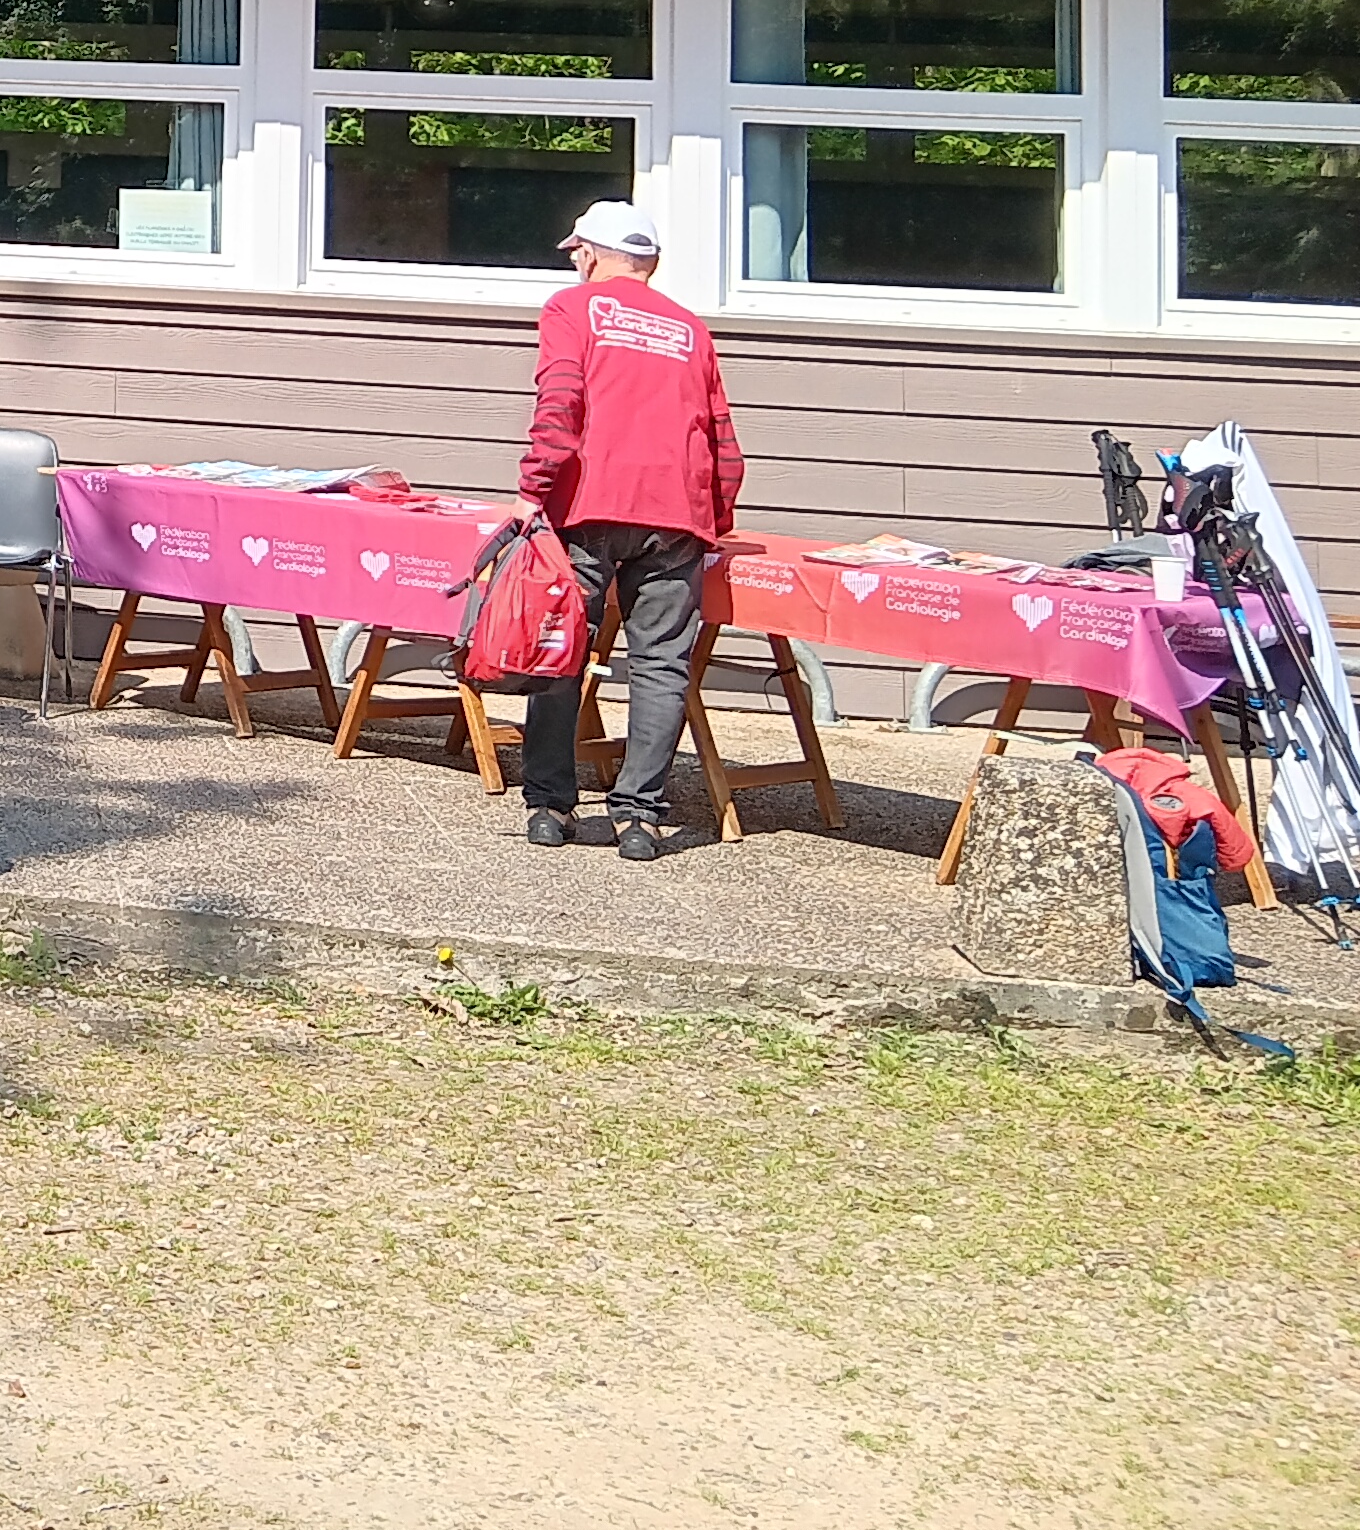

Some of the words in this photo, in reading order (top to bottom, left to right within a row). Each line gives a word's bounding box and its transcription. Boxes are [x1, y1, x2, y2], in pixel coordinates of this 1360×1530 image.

[273, 559, 326, 577] Cardiologie
[725, 571, 794, 595] Cardiologie
[885, 597, 961, 622] Cardiologie
[1060, 597, 1140, 624] Fédération
